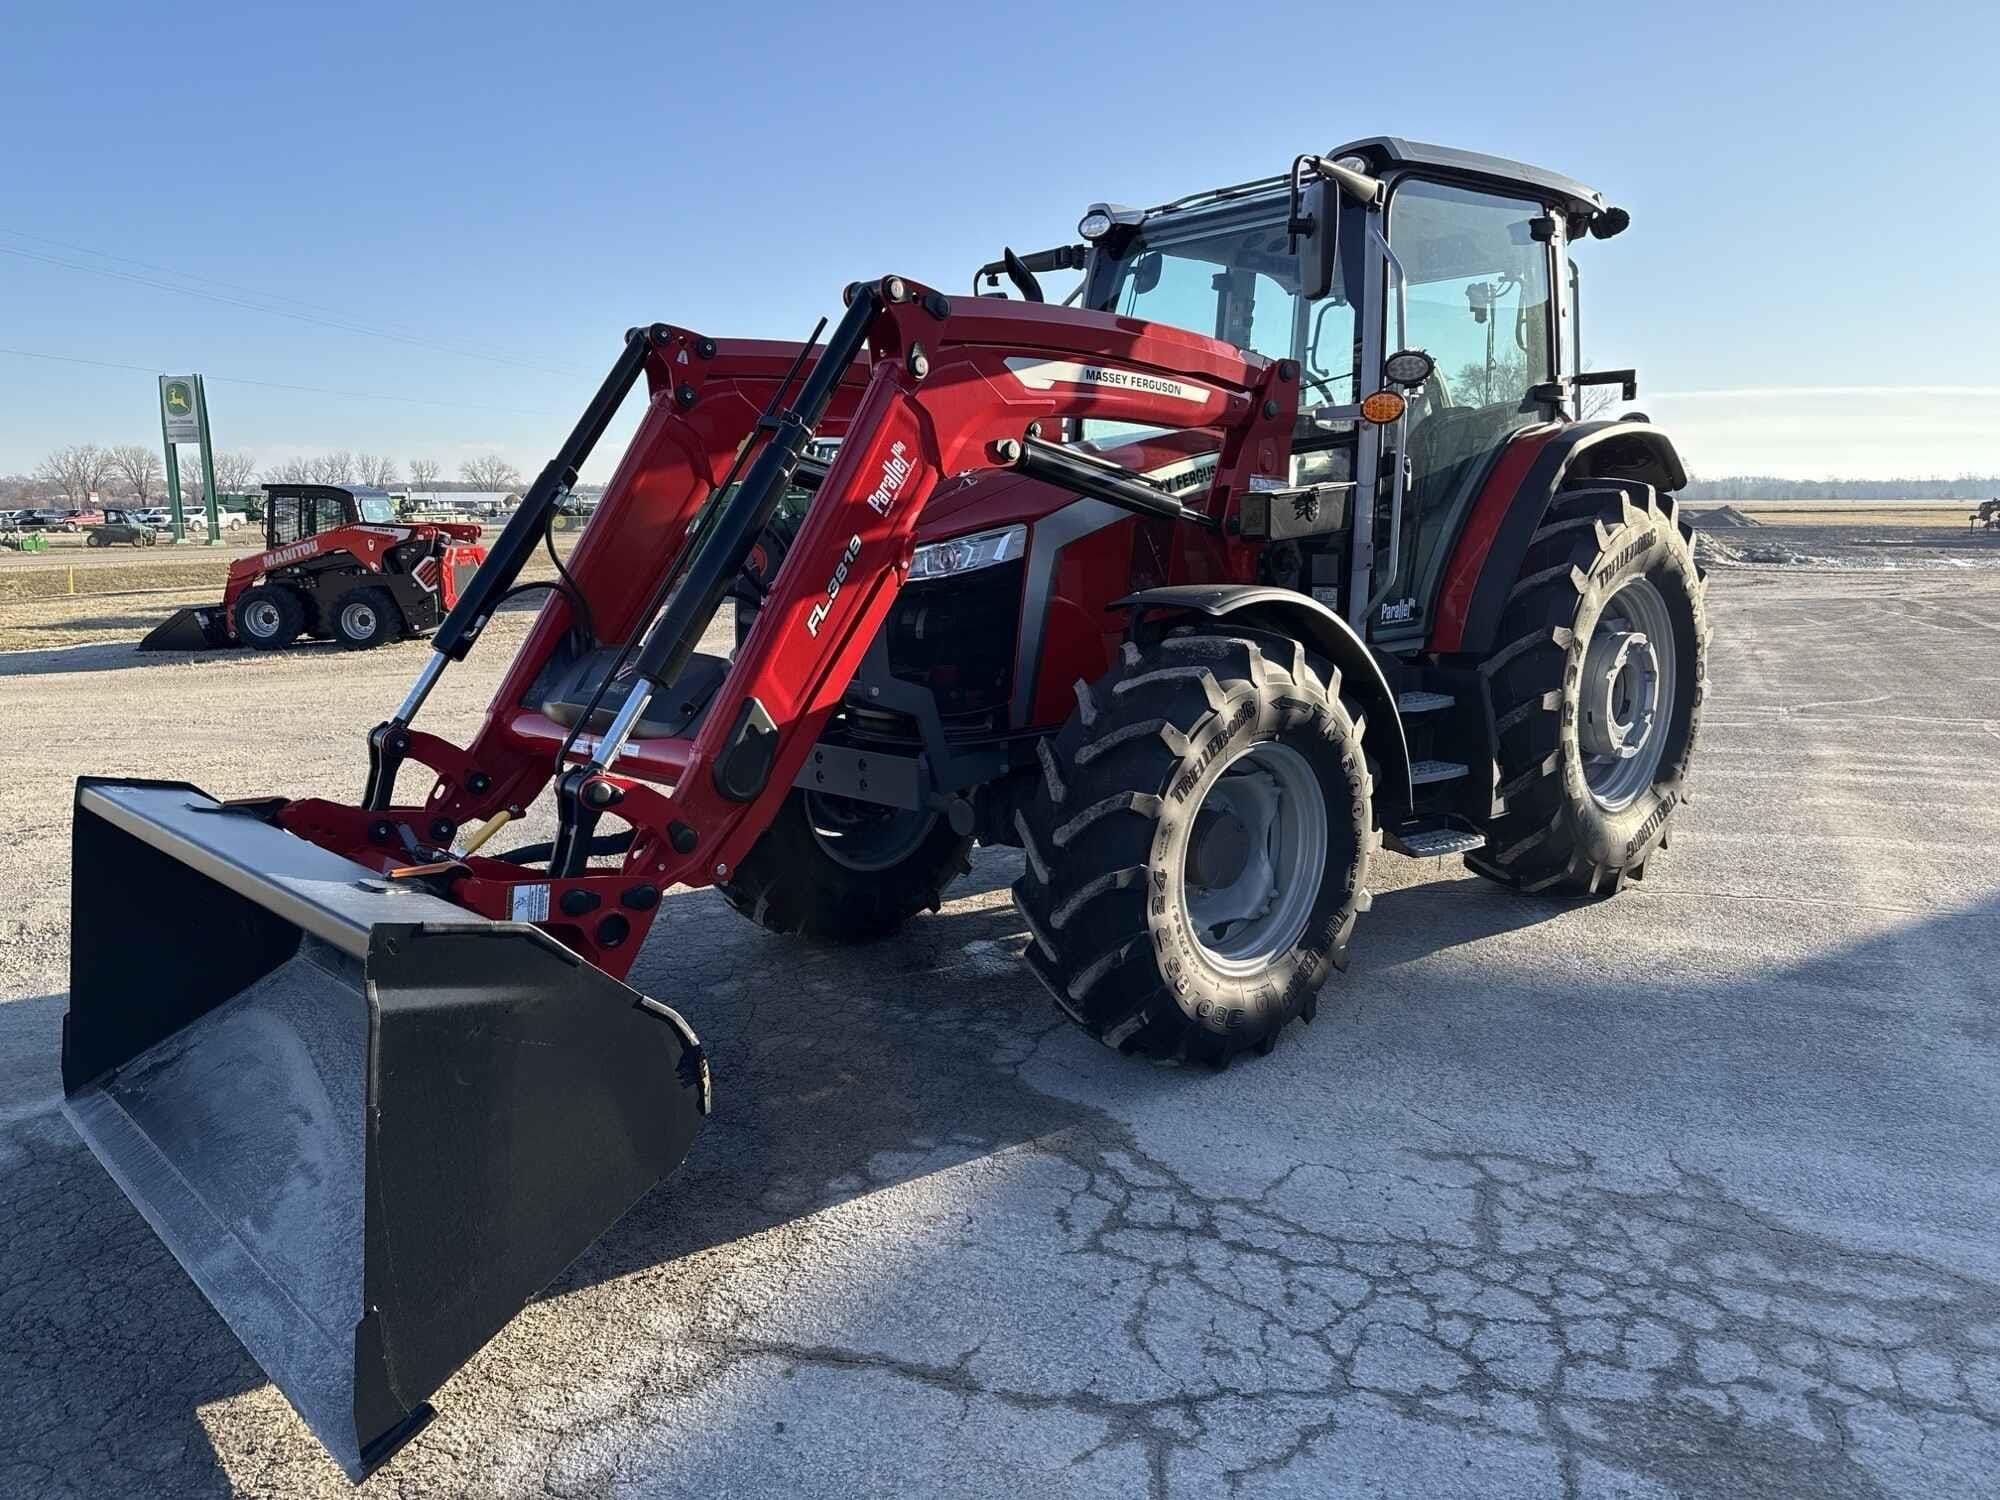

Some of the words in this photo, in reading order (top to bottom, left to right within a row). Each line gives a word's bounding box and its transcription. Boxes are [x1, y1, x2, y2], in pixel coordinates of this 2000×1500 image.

[1086, 369, 1128, 384] MASSEY
[1131, 376, 1181, 395] FERGUSON
[1176, 465, 1216, 490] FERGUS
[263, 540, 319, 568] MANITOU
[807, 533, 861, 638] FL.3819
[1170, 700, 1257, 804] TRELLEBORG
